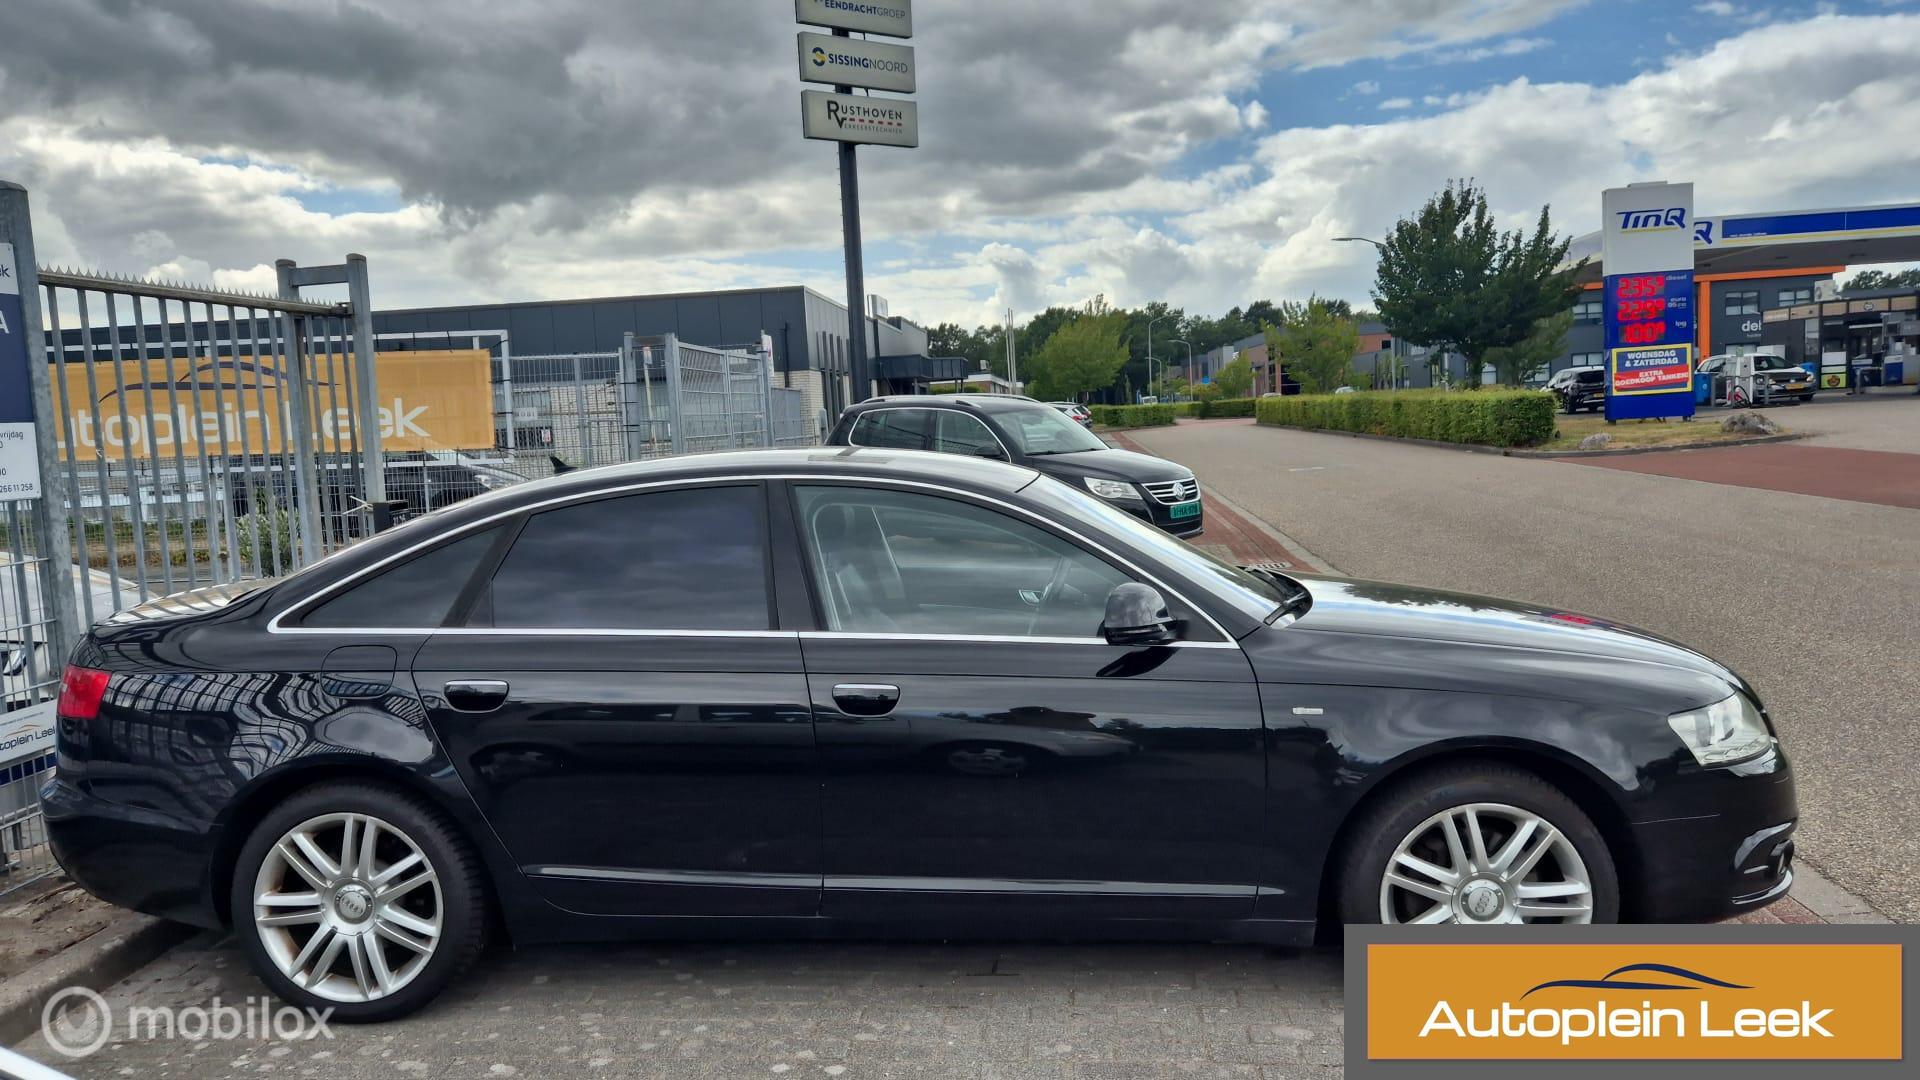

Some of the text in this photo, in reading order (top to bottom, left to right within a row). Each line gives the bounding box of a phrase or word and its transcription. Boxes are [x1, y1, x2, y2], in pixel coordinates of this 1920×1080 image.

[828, 53, 908, 74] SISSINGNOORD
[1627, 350, 1676, 360] WOENSDAG
[1633, 357, 1679, 367] ZATERDAG
